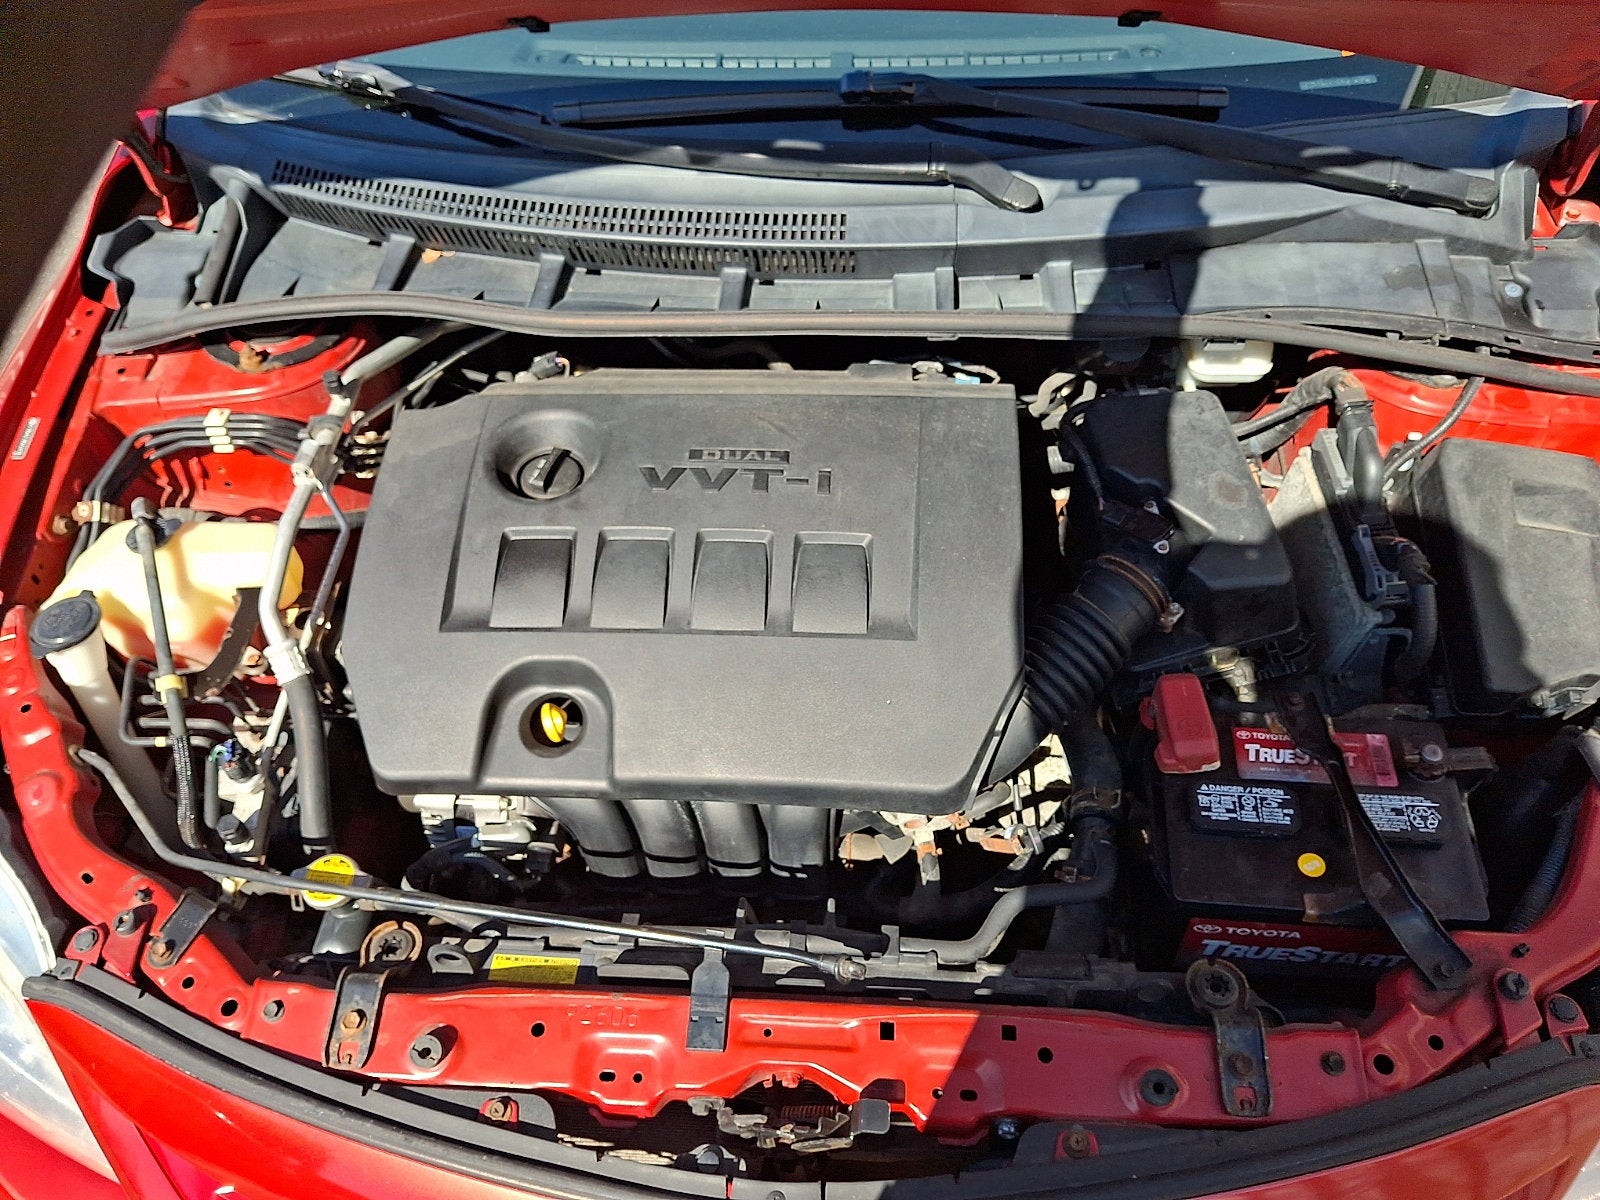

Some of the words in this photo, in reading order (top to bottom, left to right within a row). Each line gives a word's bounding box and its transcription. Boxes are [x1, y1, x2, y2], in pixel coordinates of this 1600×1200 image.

[702, 449, 782, 462] DUAL
[1251, 731, 1291, 741] TOYOTA
[1208, 784, 1244, 793] DANGER
[1251, 786, 1284, 796] POISON
[1226, 926, 1301, 939] TOYOTA
